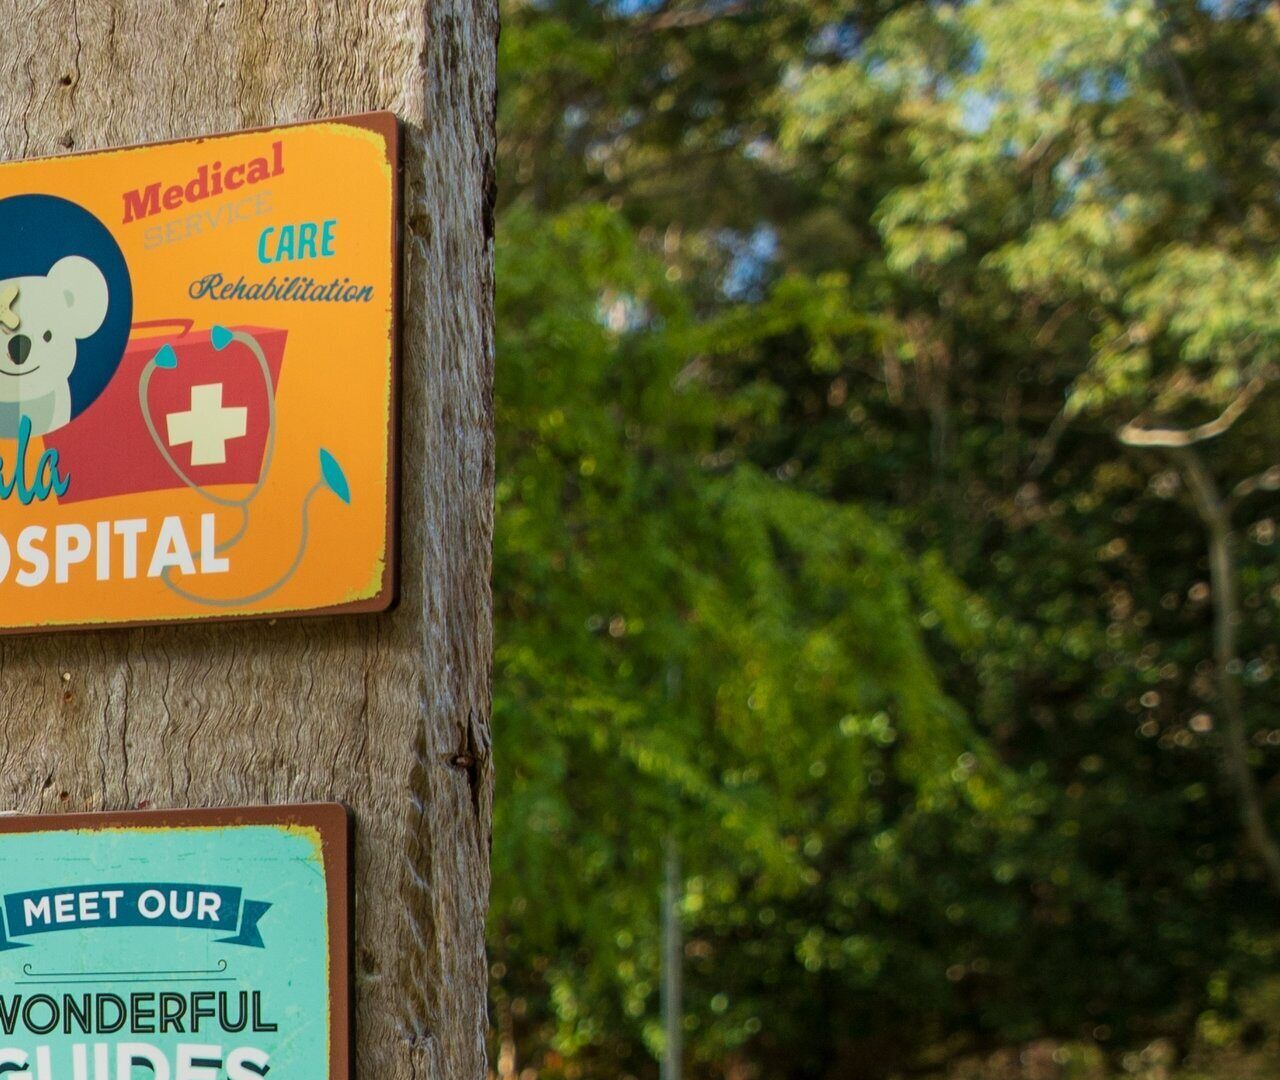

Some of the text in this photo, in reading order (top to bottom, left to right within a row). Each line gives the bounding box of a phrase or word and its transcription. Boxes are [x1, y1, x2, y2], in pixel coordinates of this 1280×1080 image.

[121, 142, 285, 225] Medical
[143, 190, 275, 250] SERVICE
[257, 219, 337, 264] CARE
[188, 272, 374, 303] Rehabilitation
[23, 889, 222, 928] MEET OUR
